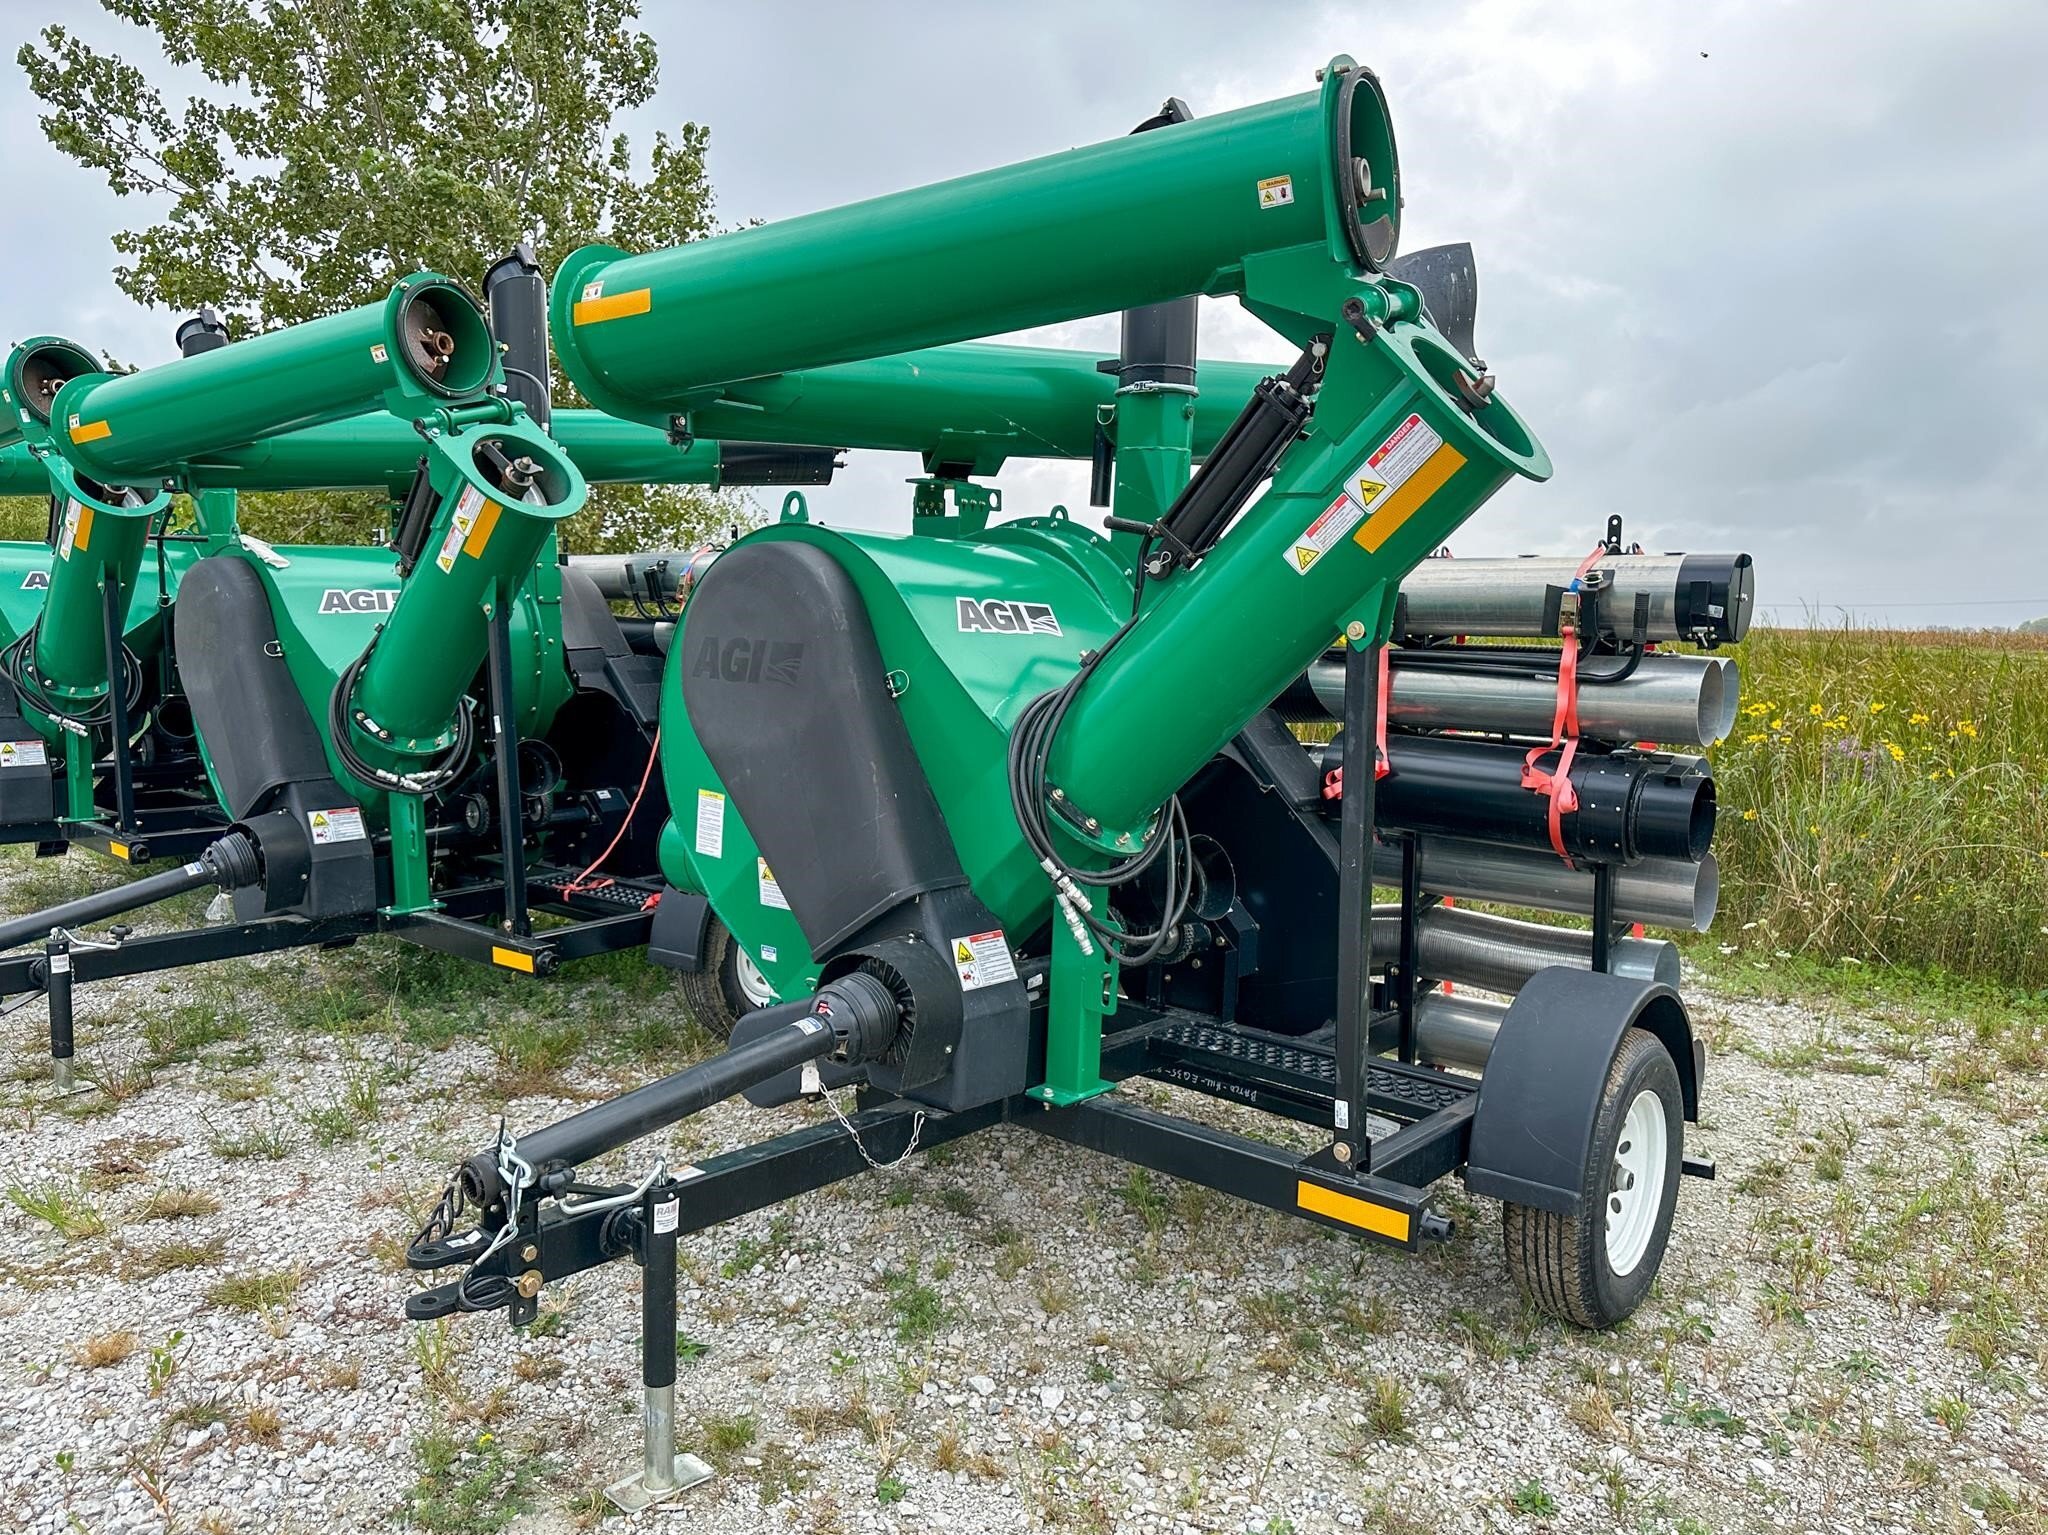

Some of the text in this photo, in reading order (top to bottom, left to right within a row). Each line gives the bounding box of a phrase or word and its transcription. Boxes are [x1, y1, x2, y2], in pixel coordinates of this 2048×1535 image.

[1385, 422, 1414, 450] DANGER
[322, 590, 389, 612] AGI
[959, 599, 1030, 632] AGI
[692, 636, 767, 684] AGI
